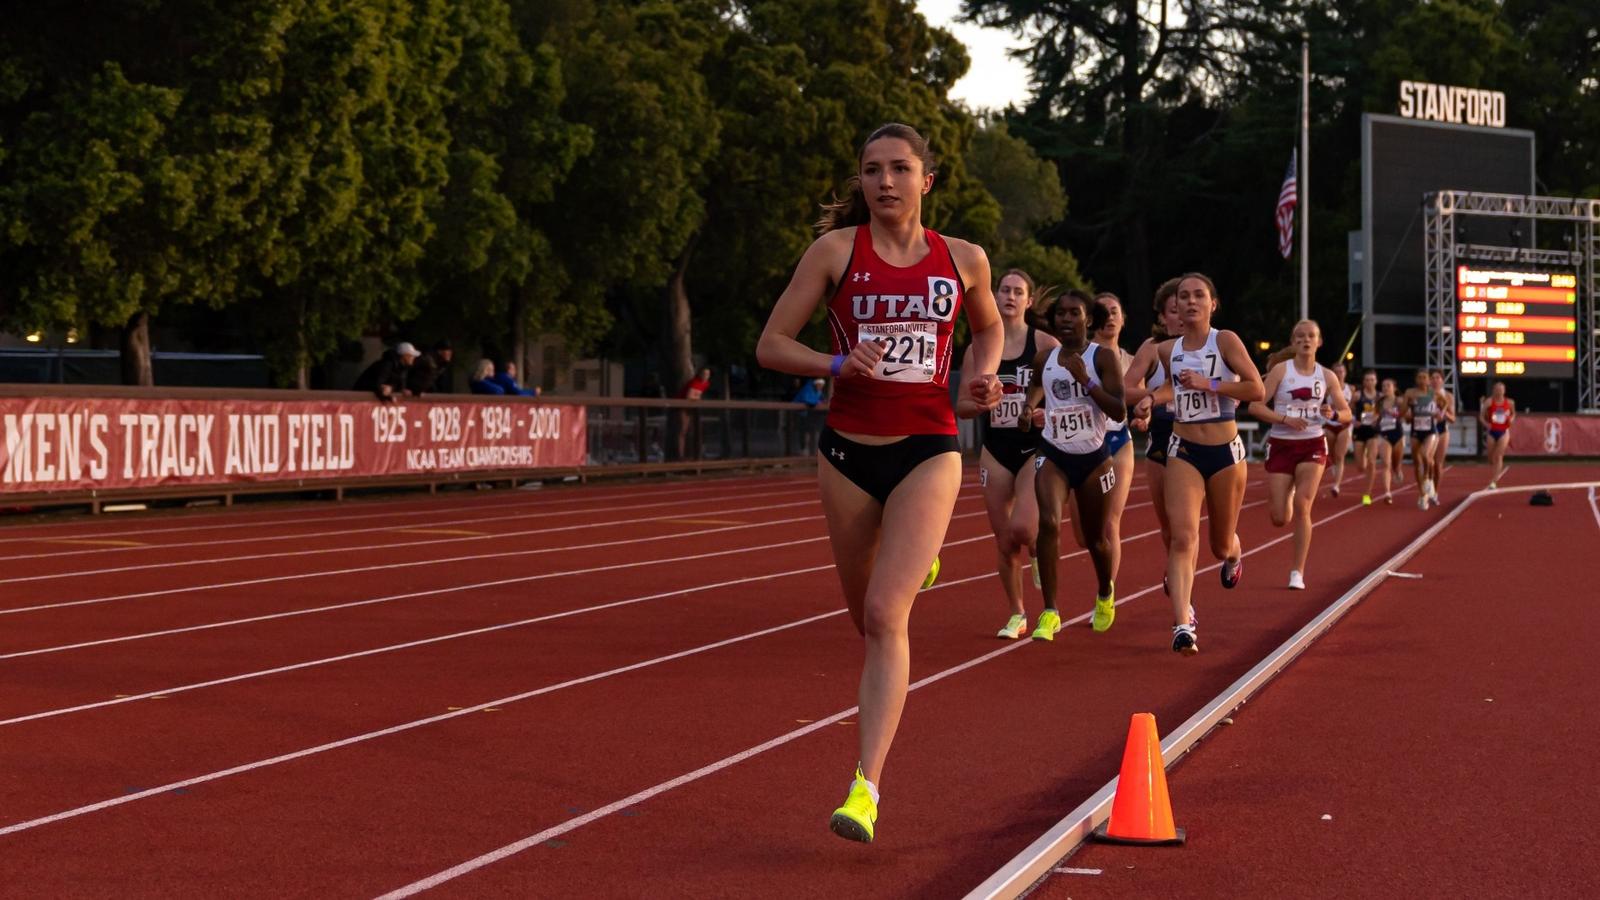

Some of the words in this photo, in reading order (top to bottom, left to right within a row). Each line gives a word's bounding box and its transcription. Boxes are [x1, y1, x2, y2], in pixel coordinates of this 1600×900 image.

[1400, 80, 1506, 127] STANFORD
[852, 295, 929, 319] UTA
[933, 280, 953, 317] 8
[867, 324, 904, 334] STANFORD
[905, 323, 928, 333] INVITE
[873, 336, 925, 364] 221
[1205, 354, 1217, 377] 7
[1314, 381, 1321, 396] 6
[1183, 392, 1208, 410] 761
[371, 406, 407, 443] 1925
[428, 406, 461, 442] 1928
[480, 406, 512, 440] 1934
[528, 407, 561, 440] 2000
[1060, 413, 1084, 432] 451
[4, 409, 108, 483] MEN'S
[120, 414, 215, 479] TRACK
[225, 414, 280, 474] AND
[287, 414, 355, 472] FIELD
[406, 449, 437, 470] NCAA
[438, 448, 465, 468] TEAM
